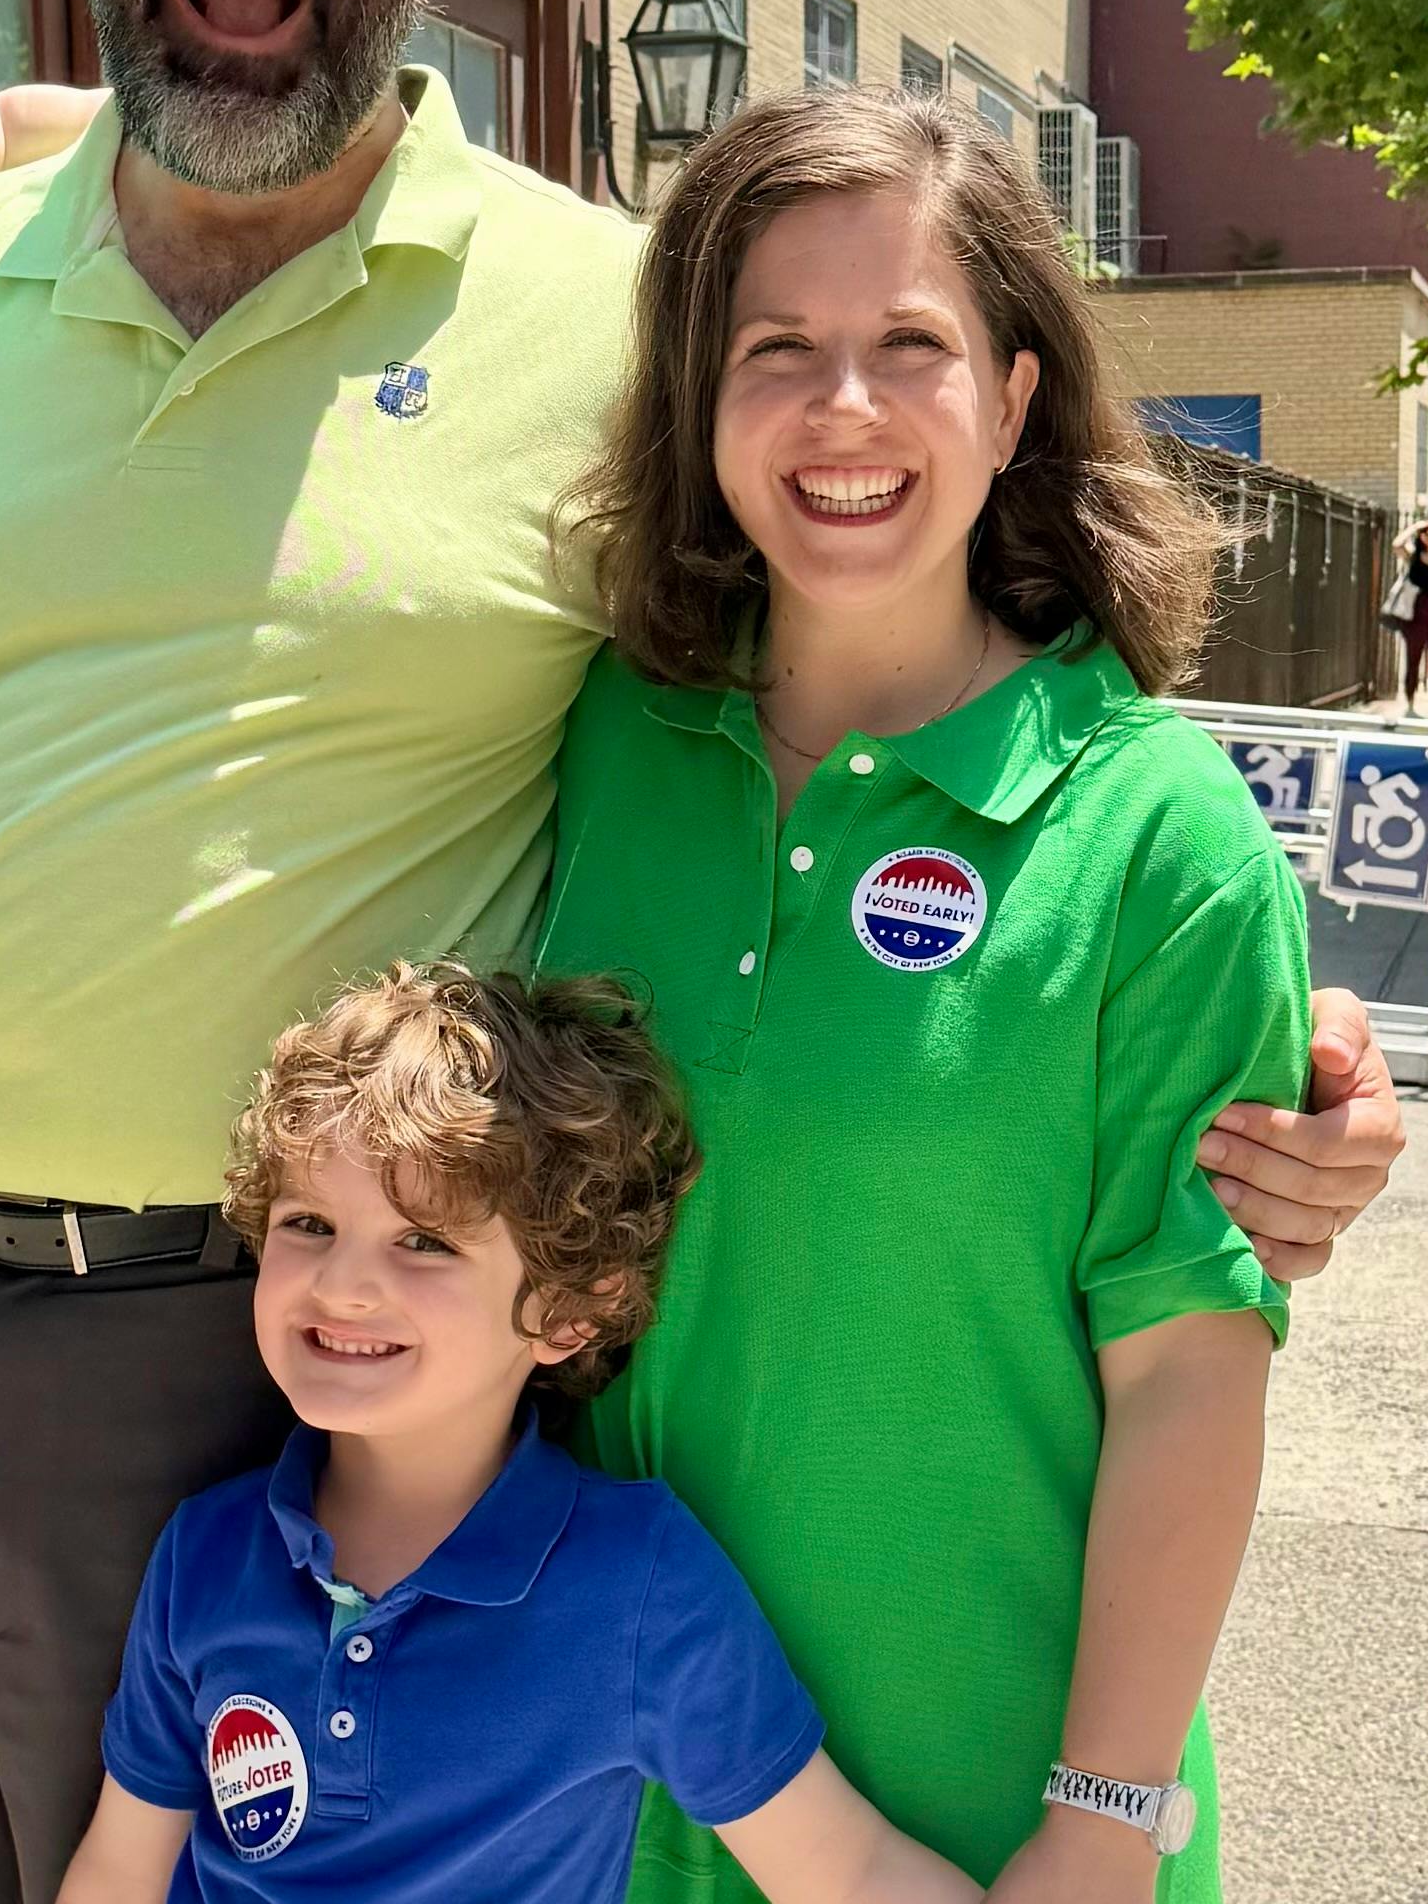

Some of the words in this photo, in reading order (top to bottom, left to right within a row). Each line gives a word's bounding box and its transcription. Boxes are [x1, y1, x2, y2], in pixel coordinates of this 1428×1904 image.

[865, 893, 871, 904] I
[872, 892, 920, 914] VOTED
[923, 904, 975, 924] EARLY!
[244, 1759, 294, 1792] VOTER
